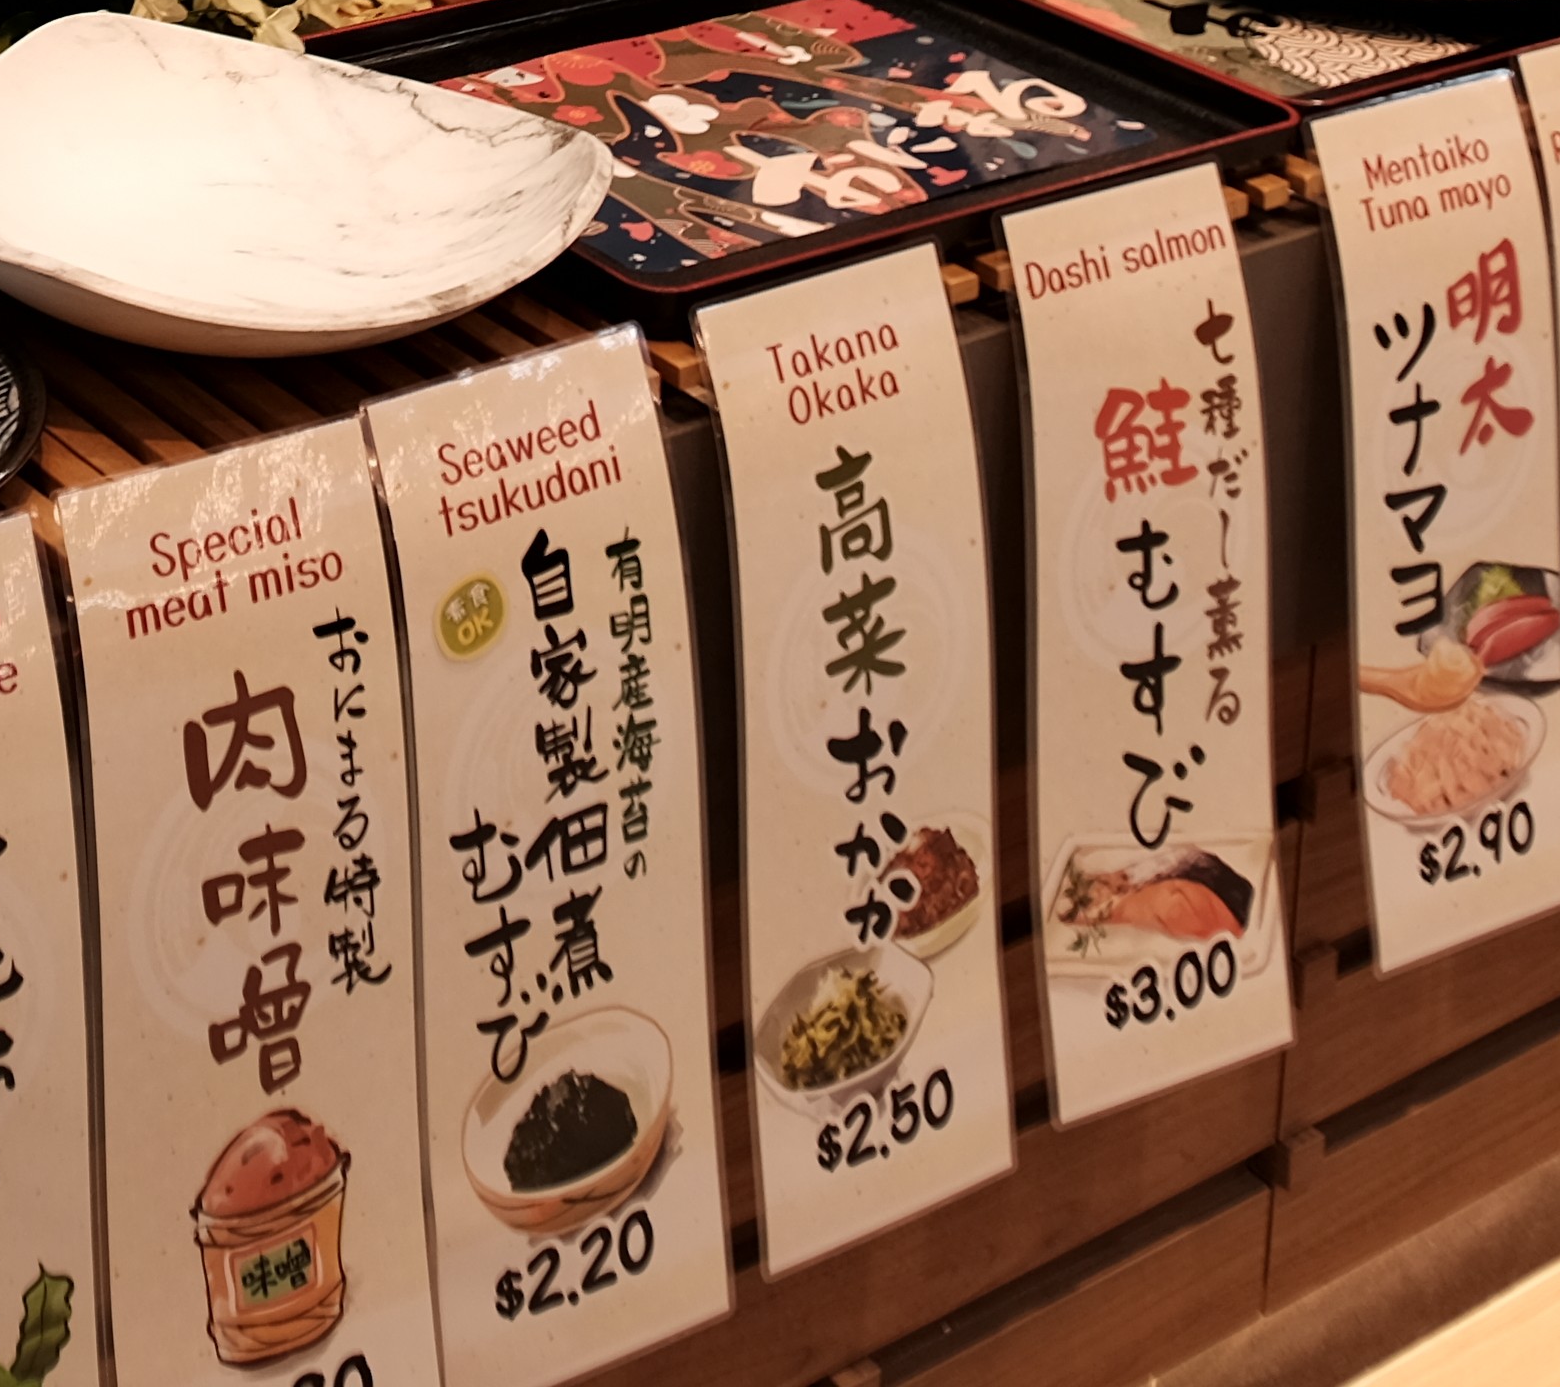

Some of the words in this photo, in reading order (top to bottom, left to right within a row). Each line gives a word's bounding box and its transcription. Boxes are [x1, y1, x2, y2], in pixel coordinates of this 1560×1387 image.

[1360, 188, 1432, 233] Tuna
[1440, 172, 1512, 225] mayo
[1362, 136, 1491, 189] Mentaiko
[1024, 241, 1117, 302] Dashi
[1123, 222, 1227, 282] salmon
[766, 319, 899, 385] Takana
[1447, 239, 1535, 457] 明太
[787, 368, 901, 426] Okaka
[437, 401, 602, 488] Seaweed
[1372, 301, 1450, 636] ツナマヨ
[438, 448, 622, 540] tsukudani
[150, 498, 304, 582] Special
[125, 581, 229, 641] meat
[247, 550, 344, 607] miso
[458, 605, 493, 645] OK
[1093, 377, 1206, 850] 鮭むすび
[605, 527, 661, 879] 有明産海苔の
[815, 445, 916, 944] 高菜おかか
[312, 607, 392, 997] おにまる特製
[521, 528, 613, 1004] 自家製佃煮
[182, 669, 312, 1095] 肉味噌
[1419, 800, 1535, 886] $2.90
[449, 807, 550, 1083] むすび
[1103, 939, 1239, 1030] $3.00
[816, 1068, 955, 1174] $2.50
[241, 1238, 314, 1300] 味噌
[496, 1209, 654, 1324] $2.20
